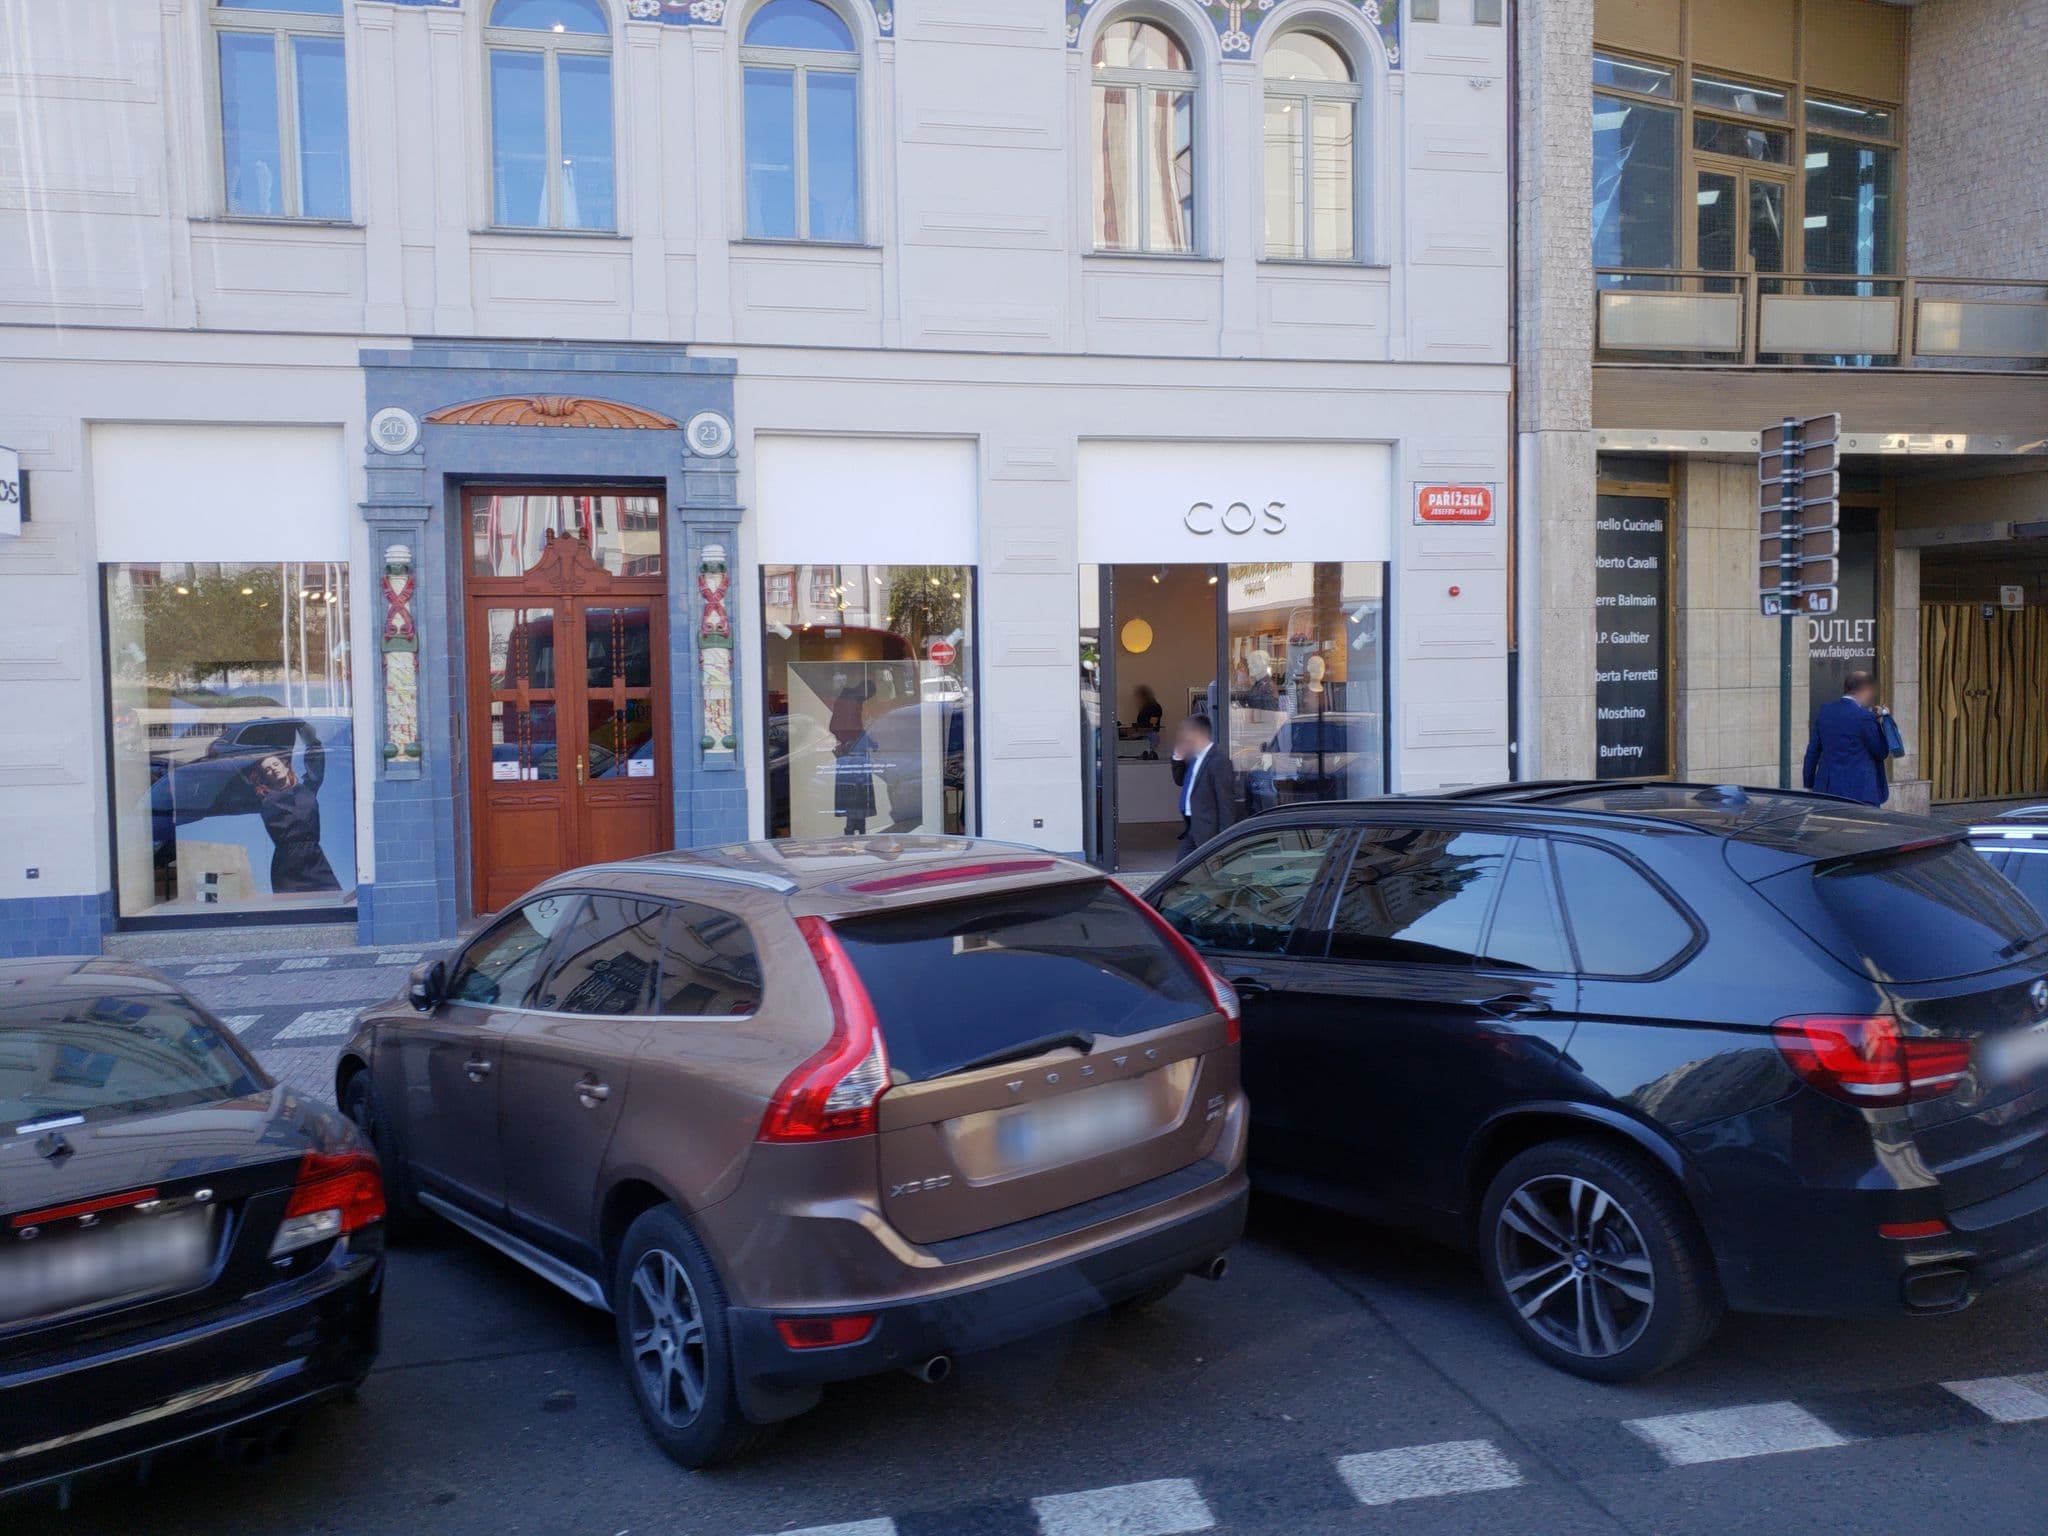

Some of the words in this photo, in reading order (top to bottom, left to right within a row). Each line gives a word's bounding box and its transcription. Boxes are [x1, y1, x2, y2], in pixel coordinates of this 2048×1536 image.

[382, 421, 406, 436] 205
[700, 426, 718, 441] 23
[1428, 491, 1484, 507] PAŘÍŽSKÁ
[1183, 501, 1288, 536] COS
[1623, 518, 1663, 532] Cucinelli
[1627, 557, 1658, 569] Cavalli
[1618, 594, 1657, 607] Balmain
[1610, 631, 1650, 644] Gaultier
[1808, 619, 1876, 643] OUTLET
[1623, 669, 1658, 681] Ferretti
[1598, 706, 1646, 720] Moschino
[1600, 744, 1643, 758] Burberry
[1005, 1047, 1158, 1094] VOLVO
[889, 1174, 953, 1199] XC60
